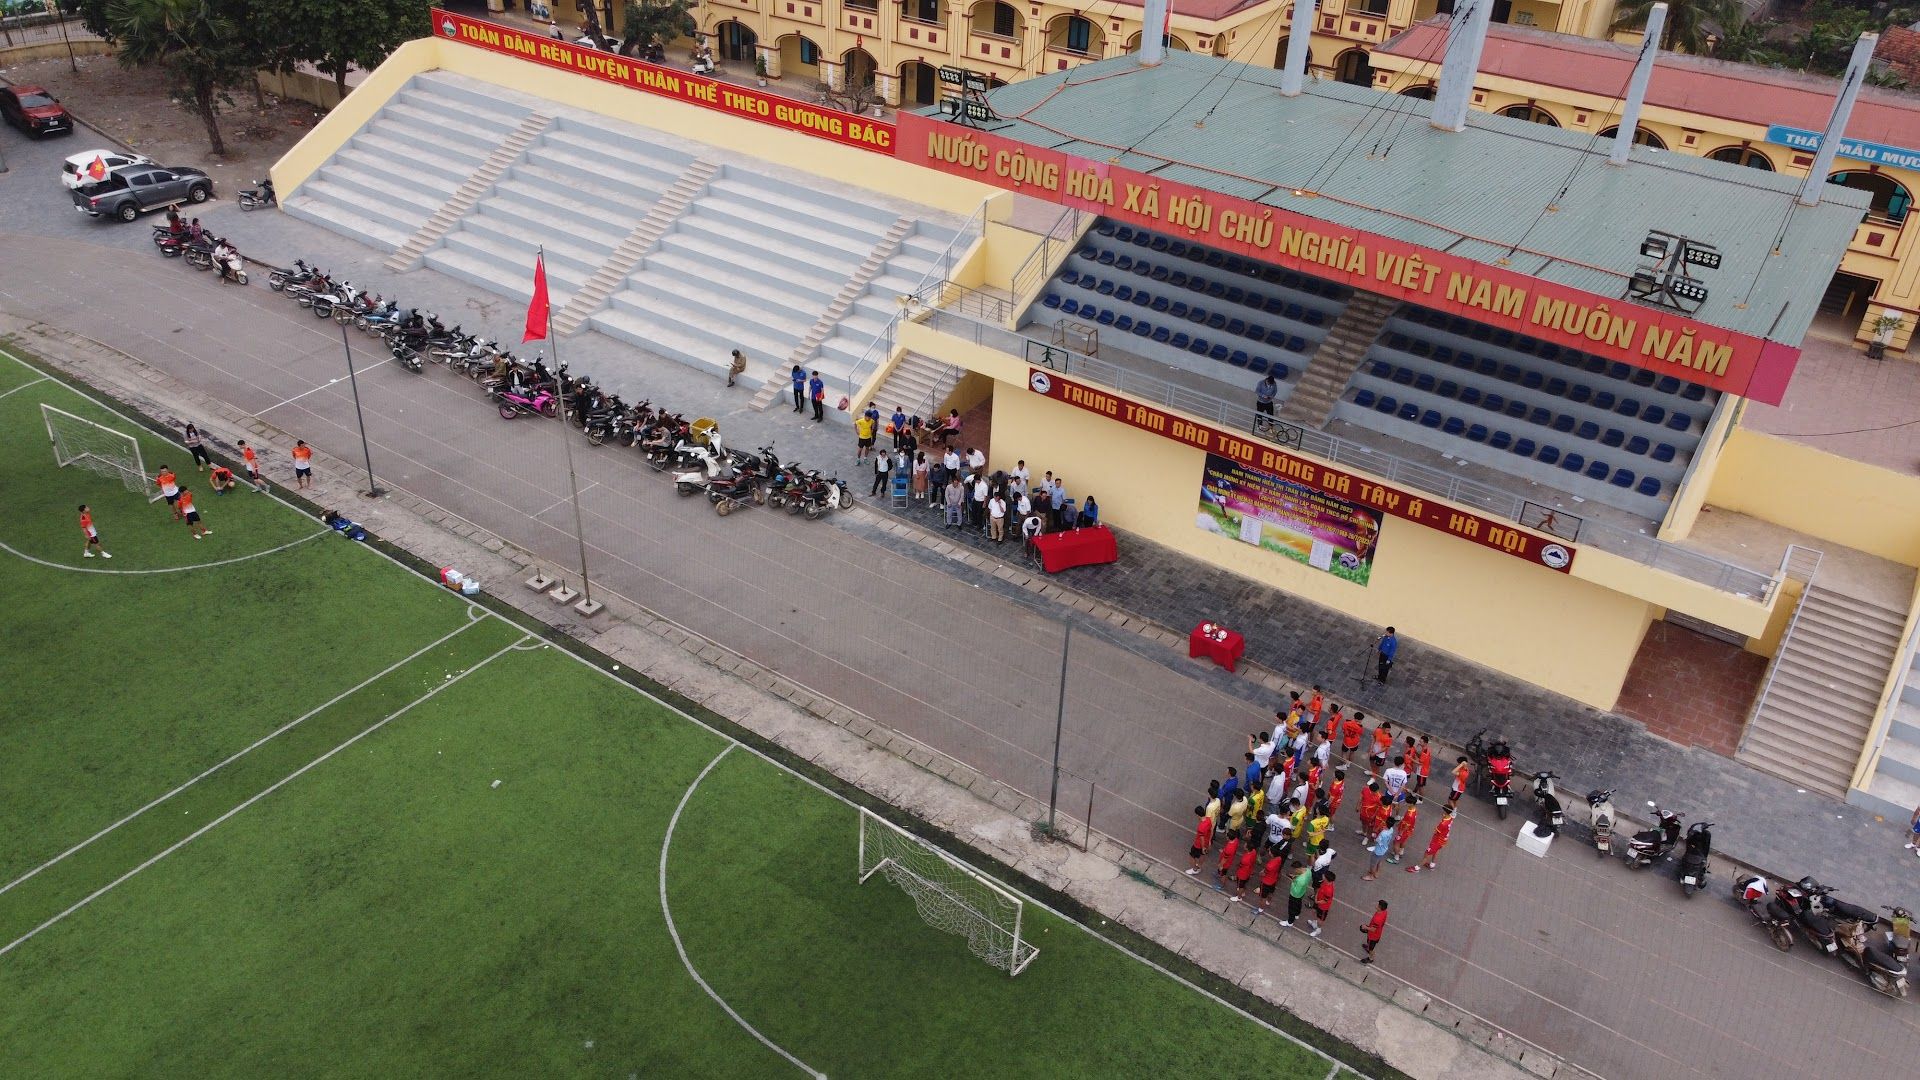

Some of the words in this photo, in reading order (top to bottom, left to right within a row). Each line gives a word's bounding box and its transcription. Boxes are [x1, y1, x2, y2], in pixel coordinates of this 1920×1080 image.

[460, 23, 500, 46] TOÀN
[503, 34, 536, 56] DÂN
[540, 43, 572, 65] RÈN
[577, 53, 630, 80] LUYỆN
[633, 67, 680, 93] THÂN
[684, 81, 719, 103] THỂ
[722, 91, 770, 116] THEO
[775, 104, 842, 135] GƯƠNG
[848, 122, 890, 147] BÁC
[927, 131, 989, 171] NƯỚC
[995, 148, 1059, 191] CỘNG
[1066, 166, 1115, 206] HÒA
[1122, 183, 1160, 219] XÃ
[1168, 195, 1213, 235] HỘI
[1218, 209, 1274, 248] CHỦ
[1279, 225, 1366, 276] NGHĨA
[1446, 271, 1527, 319] NAM
[1530, 295, 1637, 350] MUÔN
[1640, 324, 1734, 377] NĂM
[1062, 382, 1117, 415] TRUNG
[1126, 405, 1165, 431] TÂM
[1172, 420, 1209, 446] ĐÀO
[1218, 434, 1253, 461] TẠO
[1262, 451, 1315, 482] BÓNG
[1322, 471, 1350, 494] ĐÁ
[1360, 483, 1400, 511] TÂY
[1407, 499, 1424, 519] Á
[1449, 513, 1480, 538] HÀ
[1488, 527, 1528, 554] NỘI
[1271, 824, 1282, 836] 92
